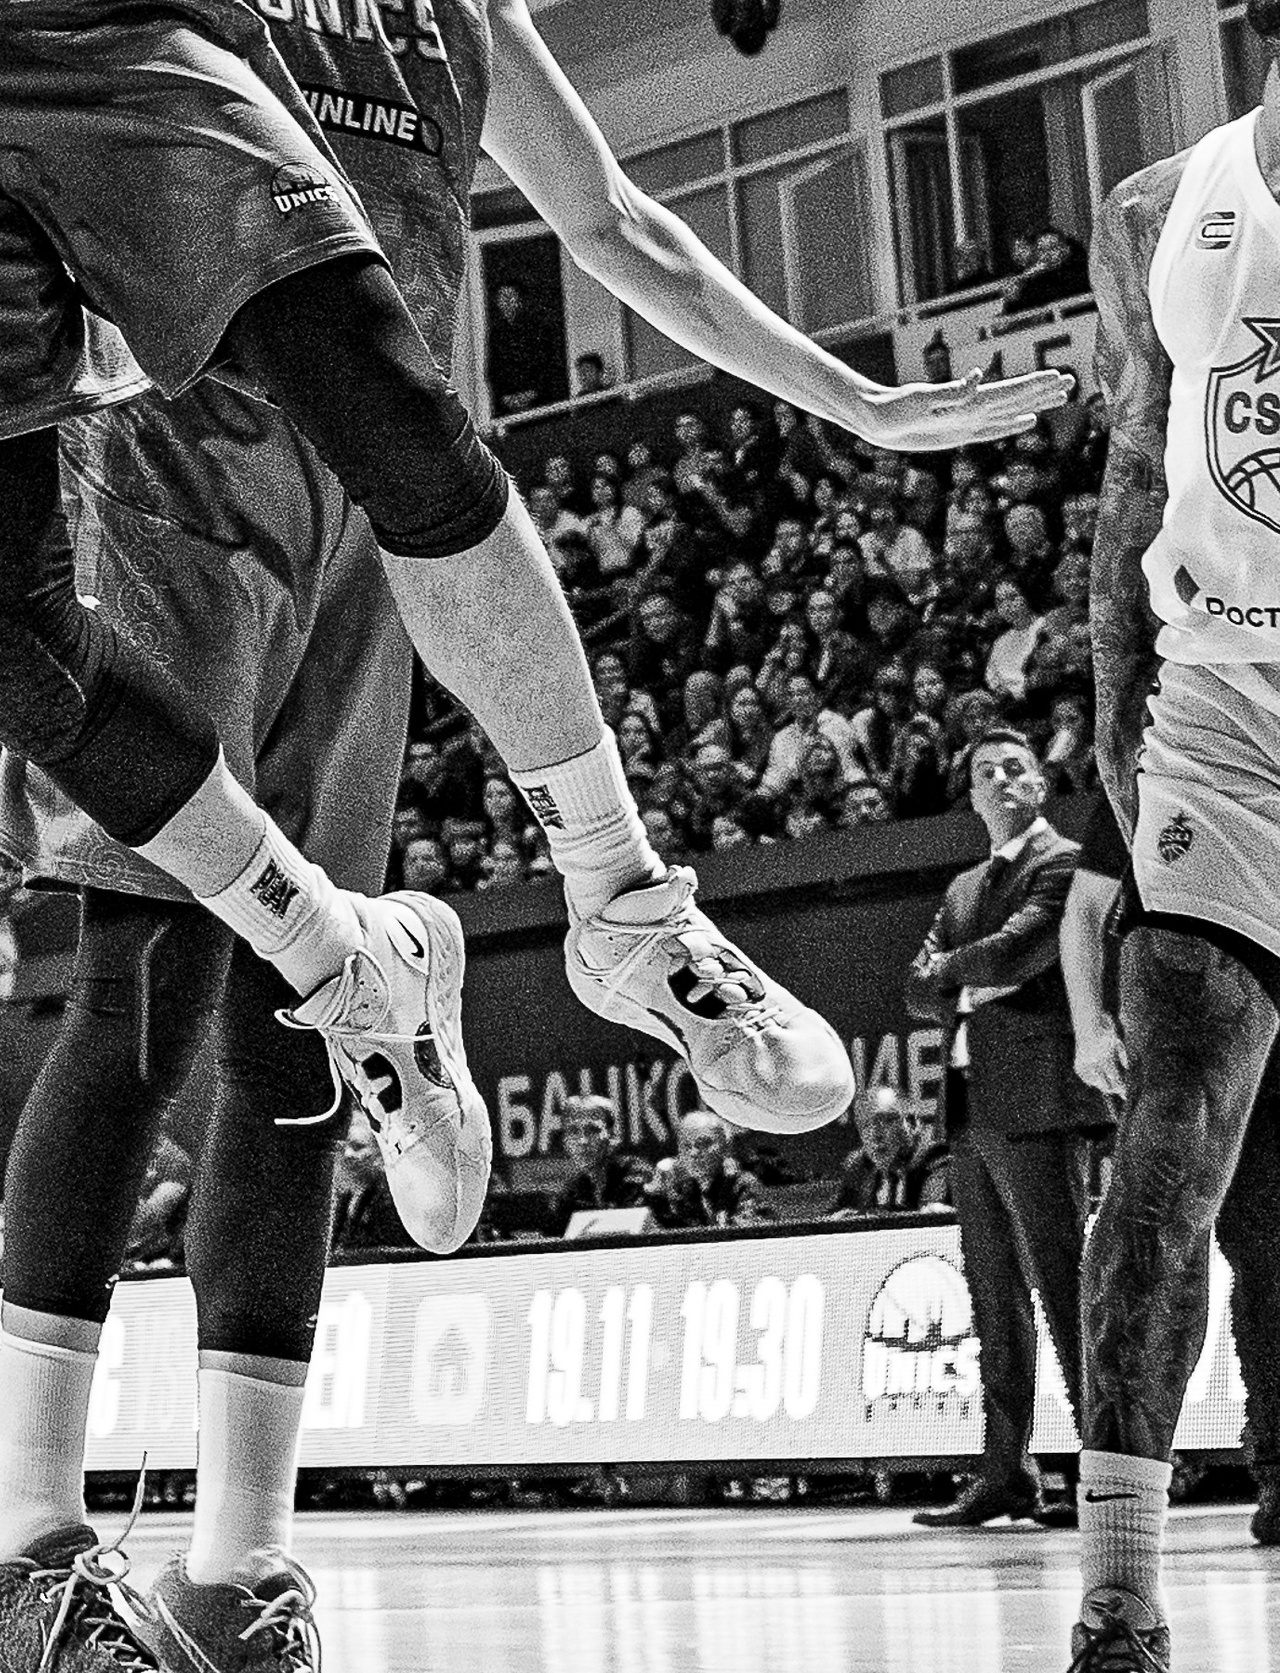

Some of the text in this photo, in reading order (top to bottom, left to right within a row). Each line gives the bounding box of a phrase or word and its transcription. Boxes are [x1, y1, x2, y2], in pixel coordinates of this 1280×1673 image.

[303, 90, 418, 141] INLINE
[273, 185, 340, 213] UNICS
[525, 1285, 654, 1427] 19.11
[679, 1273, 827, 1423] 19.30
